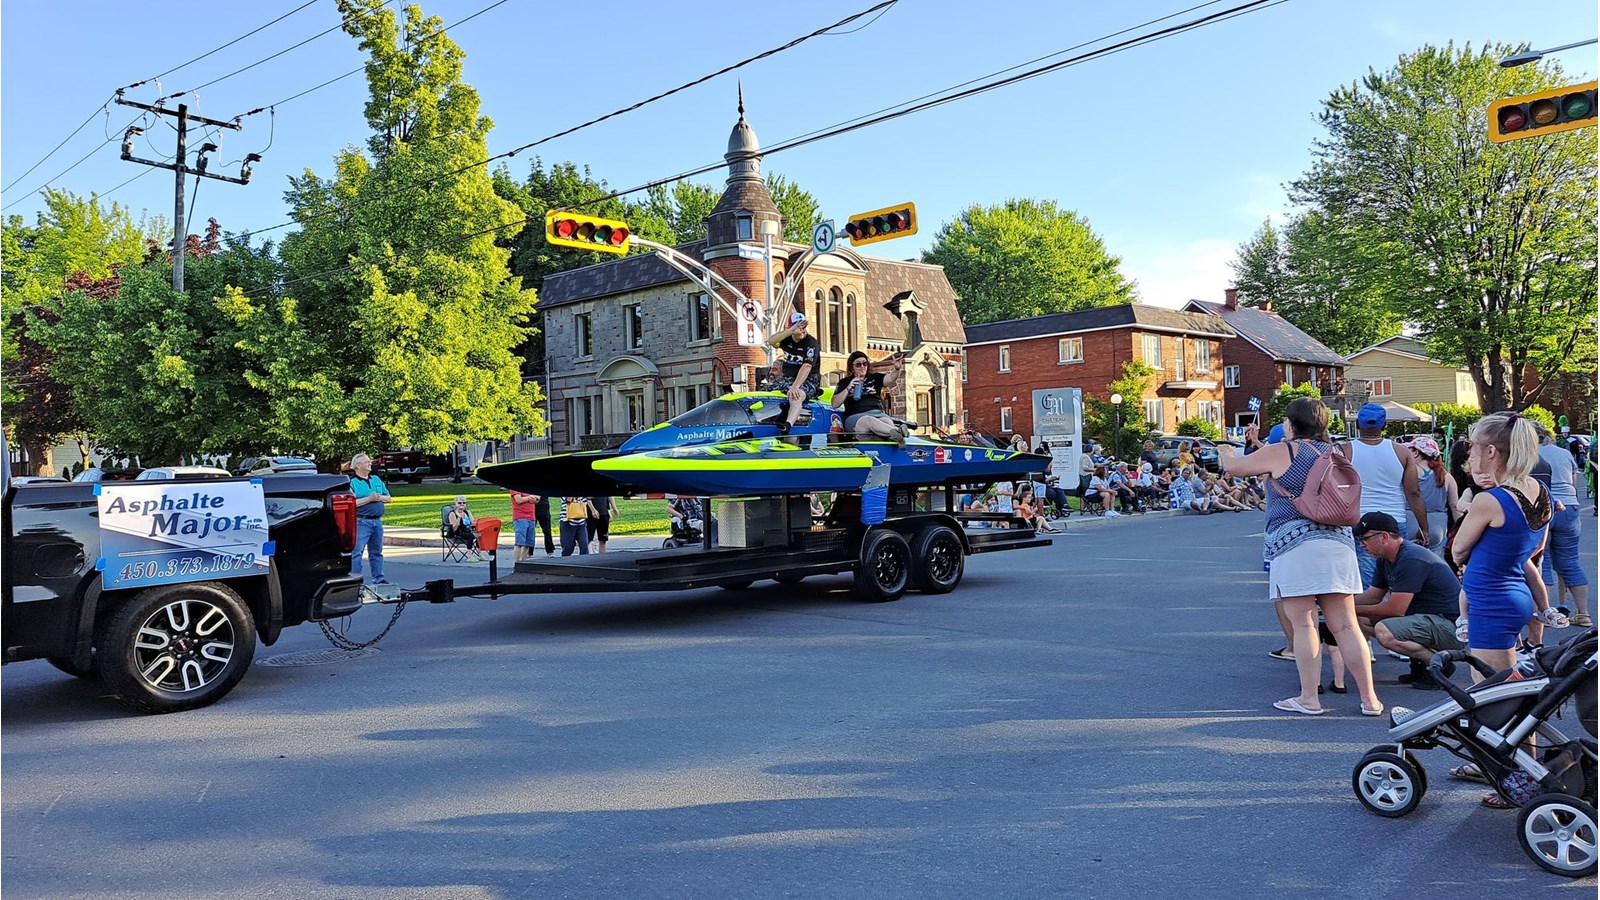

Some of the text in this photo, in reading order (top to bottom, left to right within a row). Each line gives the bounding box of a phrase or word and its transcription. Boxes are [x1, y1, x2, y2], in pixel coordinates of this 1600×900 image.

[676, 430, 715, 440] Asphalte
[105, 493, 225, 516] Asphalte
[148, 512, 247, 539] Major
[119, 552, 256, 581] 450.373.1879
